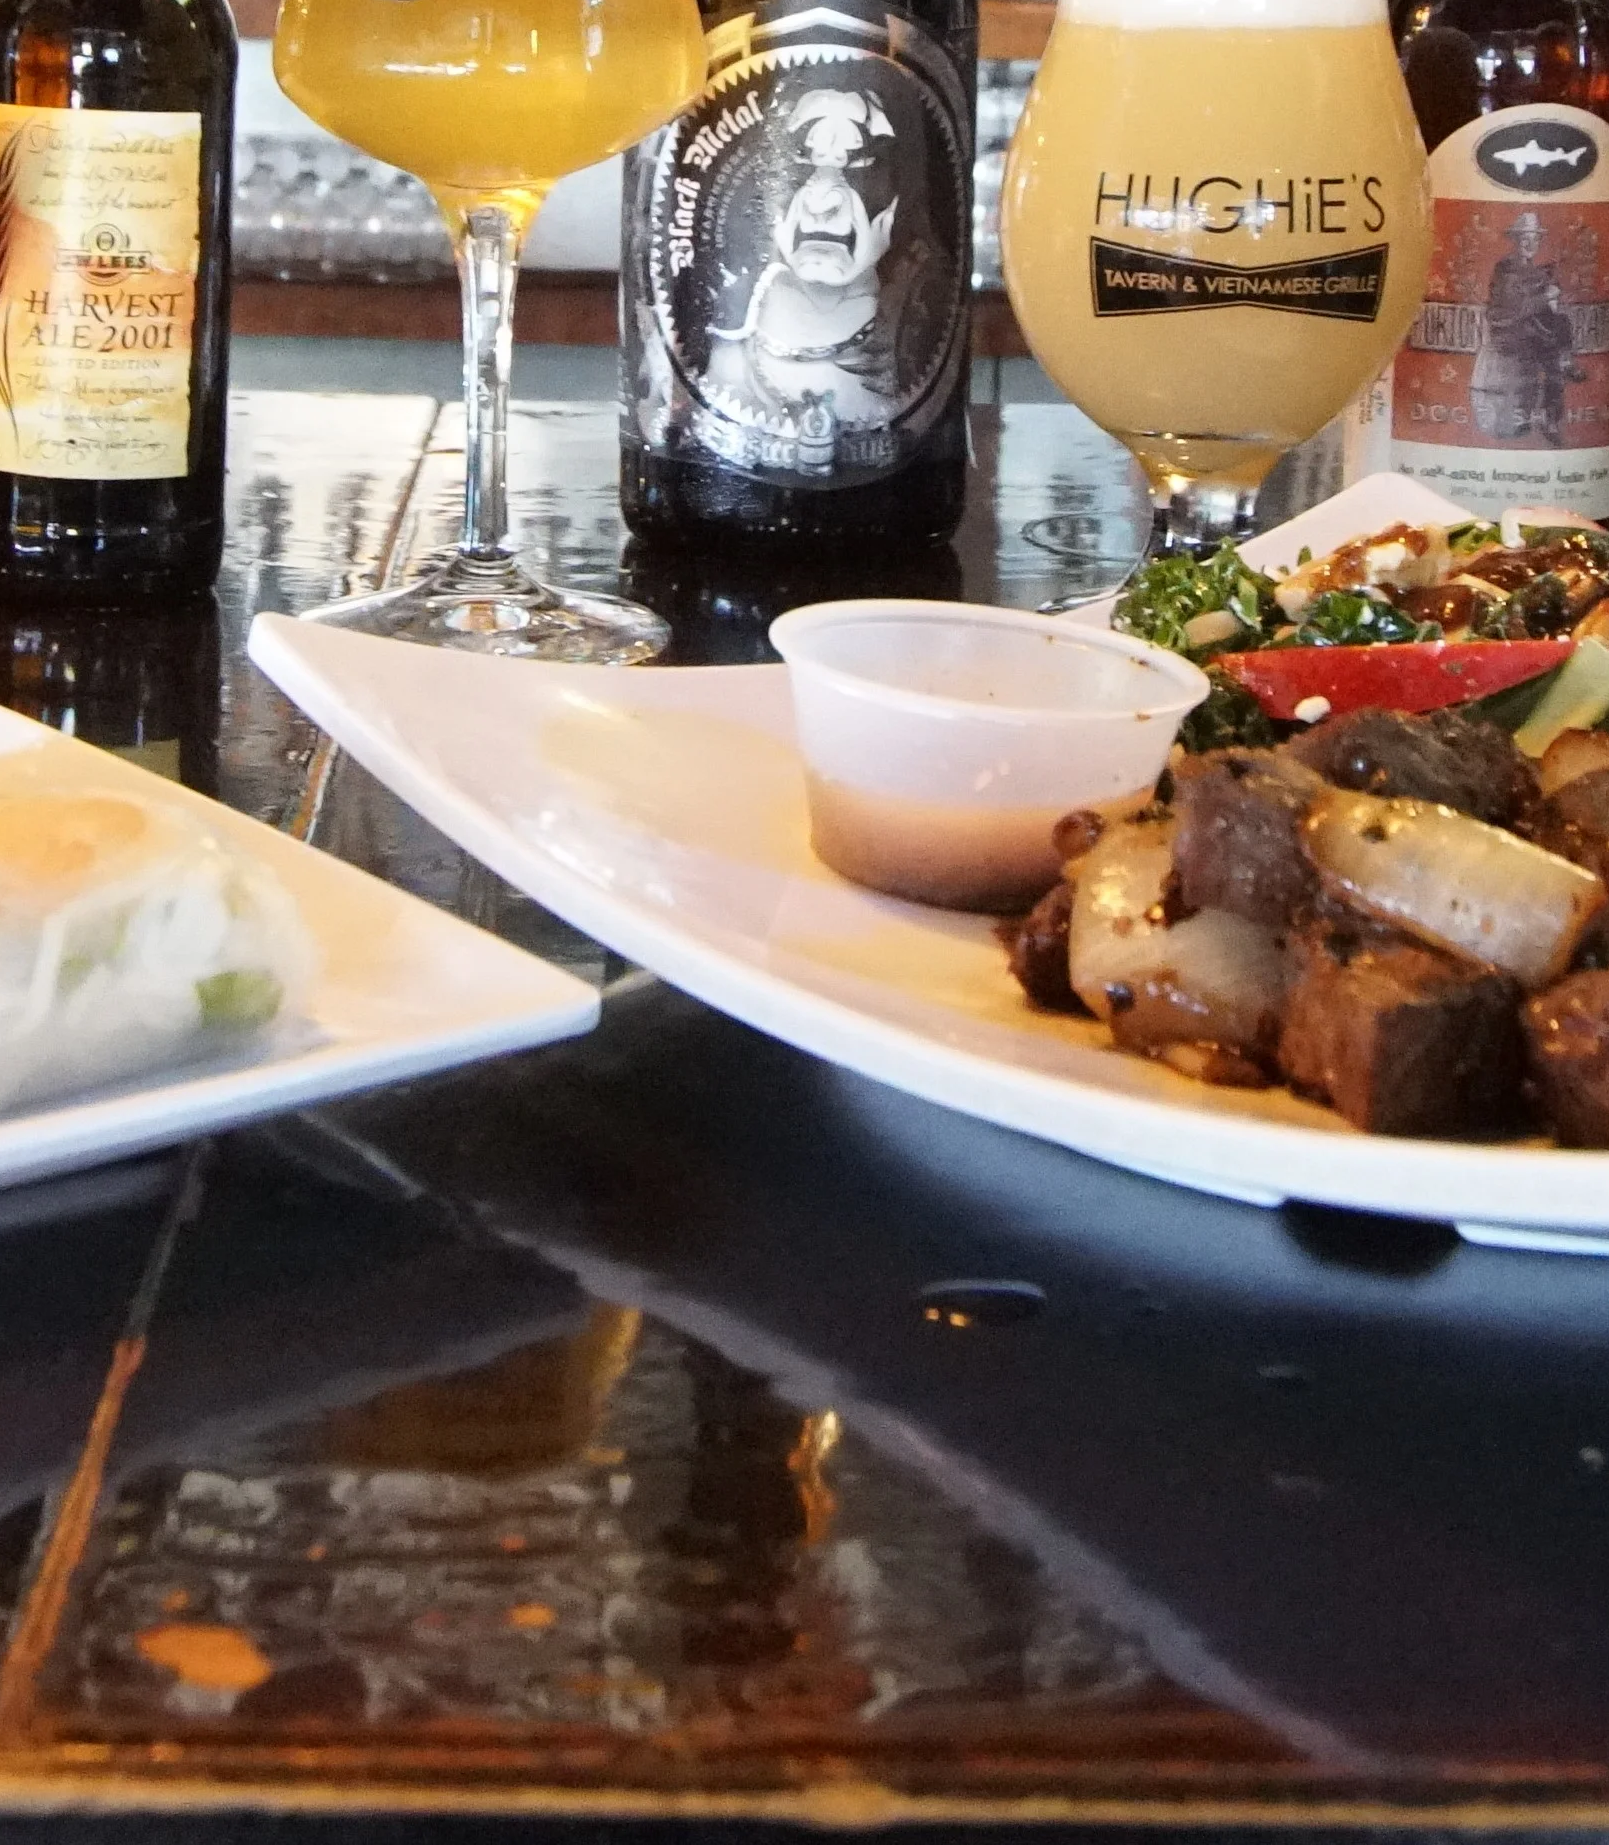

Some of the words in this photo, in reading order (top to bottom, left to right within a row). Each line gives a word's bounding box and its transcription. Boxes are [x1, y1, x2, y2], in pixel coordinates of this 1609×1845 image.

[1103, 268, 1177, 293] TAVERN
[1182, 277, 1198, 294] &
[1204, 273, 1323, 296] VIETNAMESE
[22, 289, 186, 324] HARVEST
[22, 321, 92, 349] ALE
[97, 322, 175, 353] 2001
